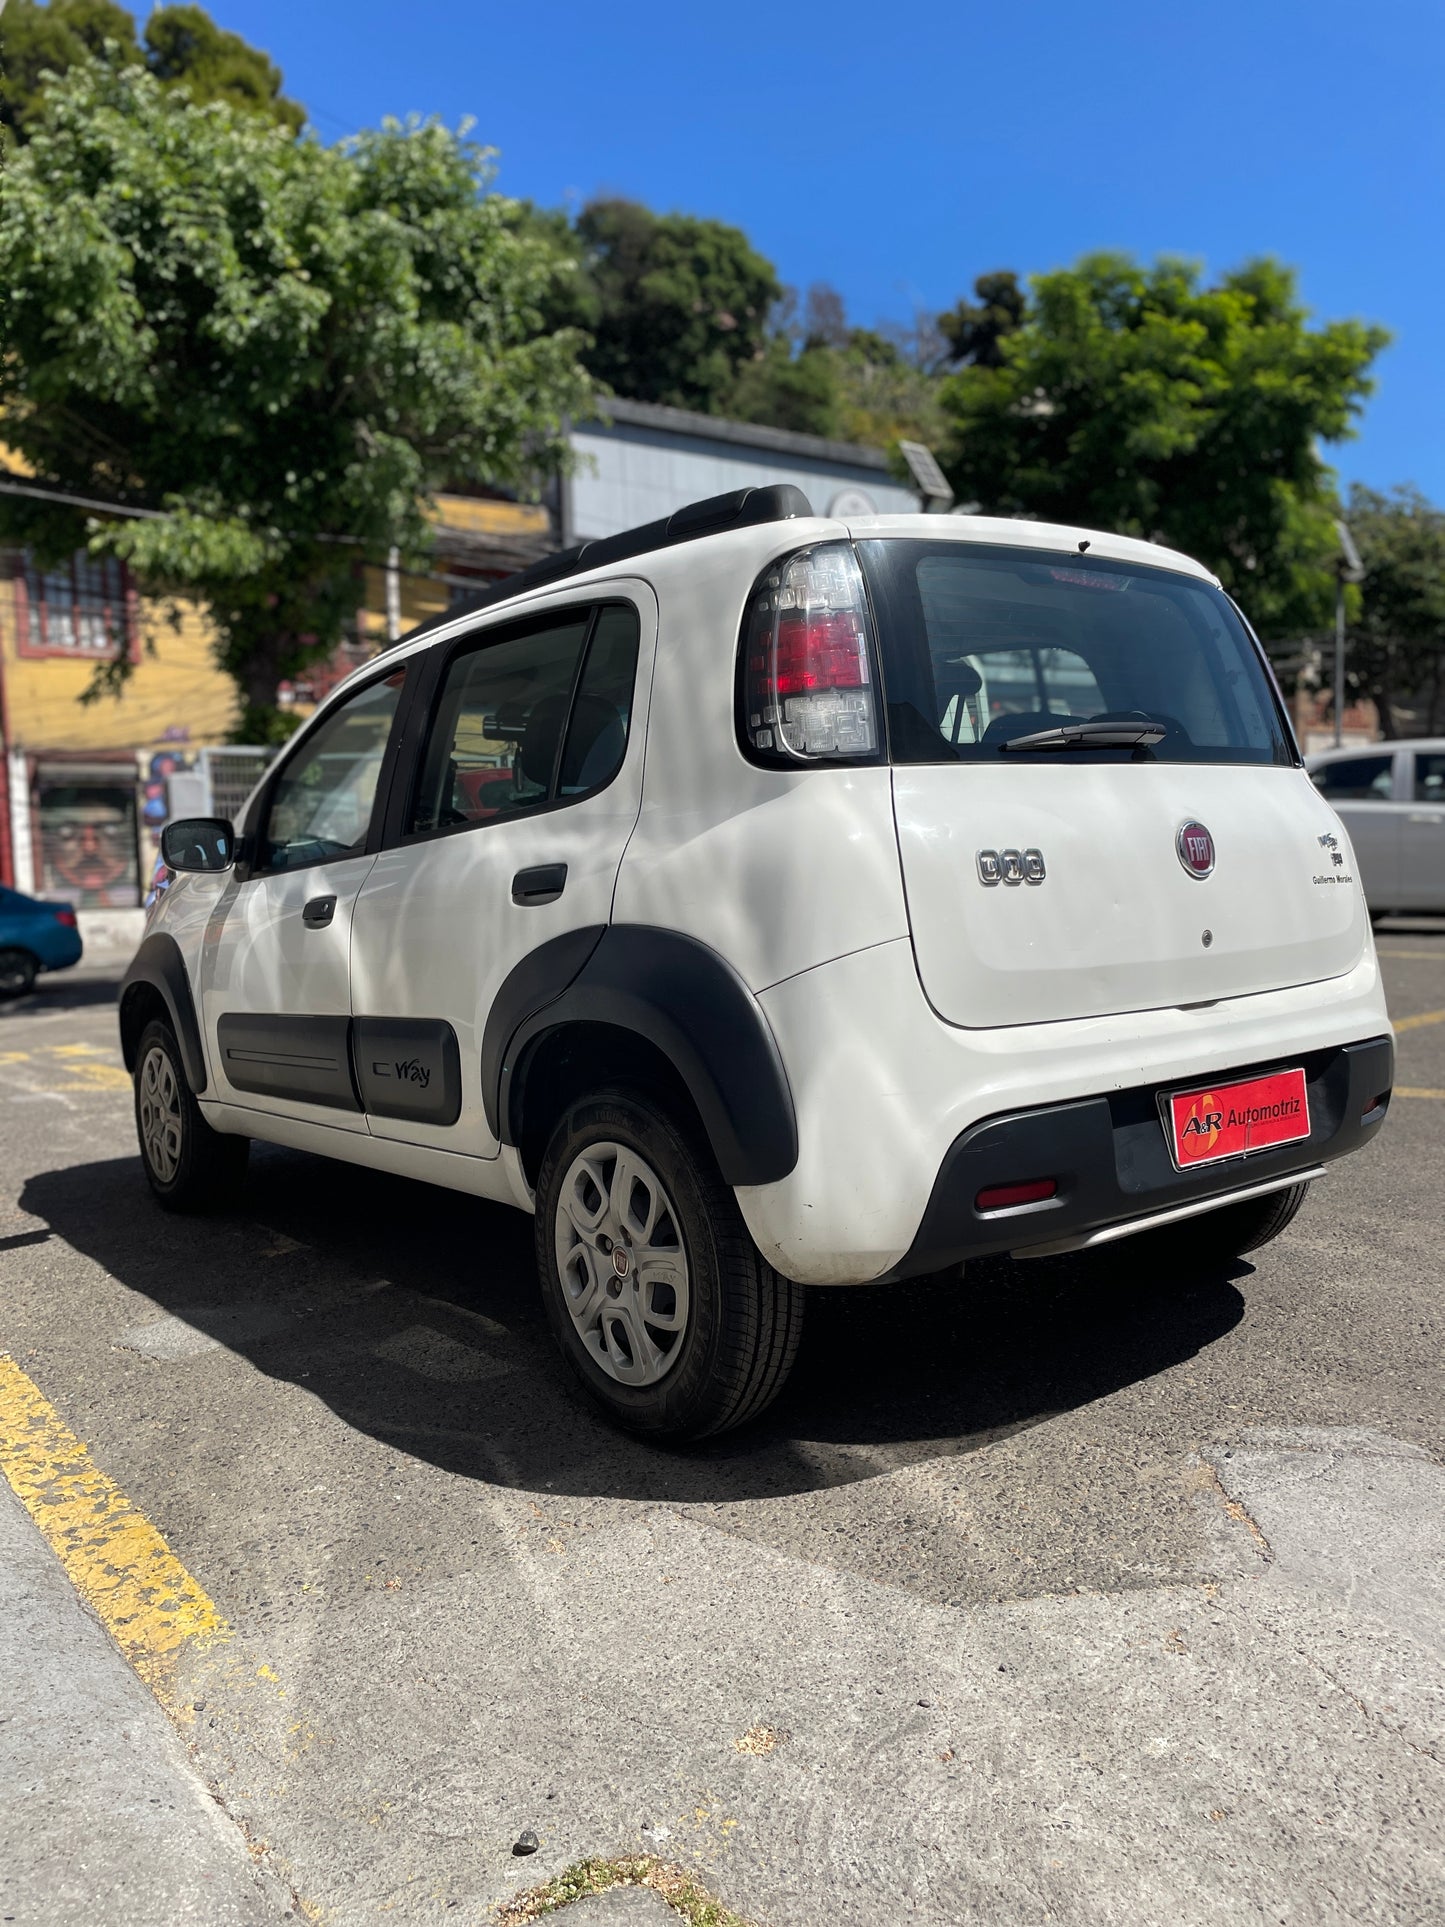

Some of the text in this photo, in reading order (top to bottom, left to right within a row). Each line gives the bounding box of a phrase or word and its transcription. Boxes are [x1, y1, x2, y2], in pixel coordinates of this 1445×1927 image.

[1186, 836, 1209, 862] FIAT
[395, 1059, 431, 1088] Way
[1181, 1112, 1223, 1139] A&R
[1226, 1096, 1301, 1129] Automotriz
